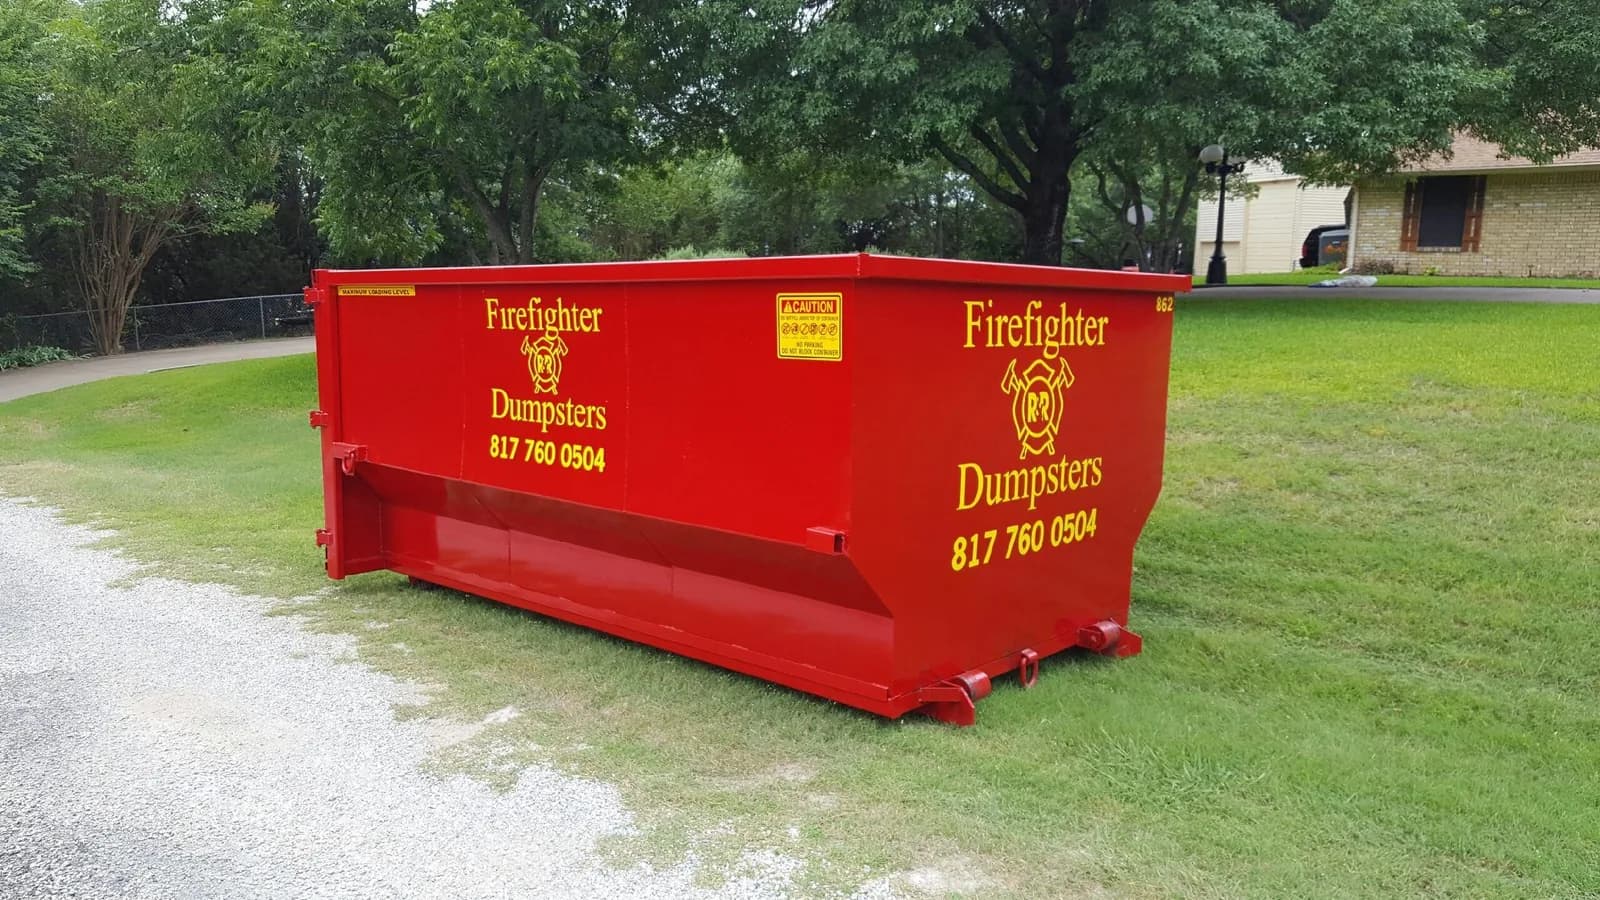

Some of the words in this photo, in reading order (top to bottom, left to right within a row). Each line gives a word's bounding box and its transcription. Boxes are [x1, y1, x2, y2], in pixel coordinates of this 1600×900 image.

[484, 297, 603, 341] Firefighter
[792, 300, 834, 313] CAUTION
[1155, 296, 1174, 313] 862
[963, 299, 1109, 360] Firefighter
[491, 388, 607, 433] Dumpsters
[489, 434, 519, 460] 817
[524, 439, 556, 466] 760
[560, 443, 606, 473] 0504
[956, 454, 1103, 511] Dumpsters
[951, 529, 998, 572] 817
[1005, 519, 1044, 560] 760
[1050, 508, 1098, 548] 0504
